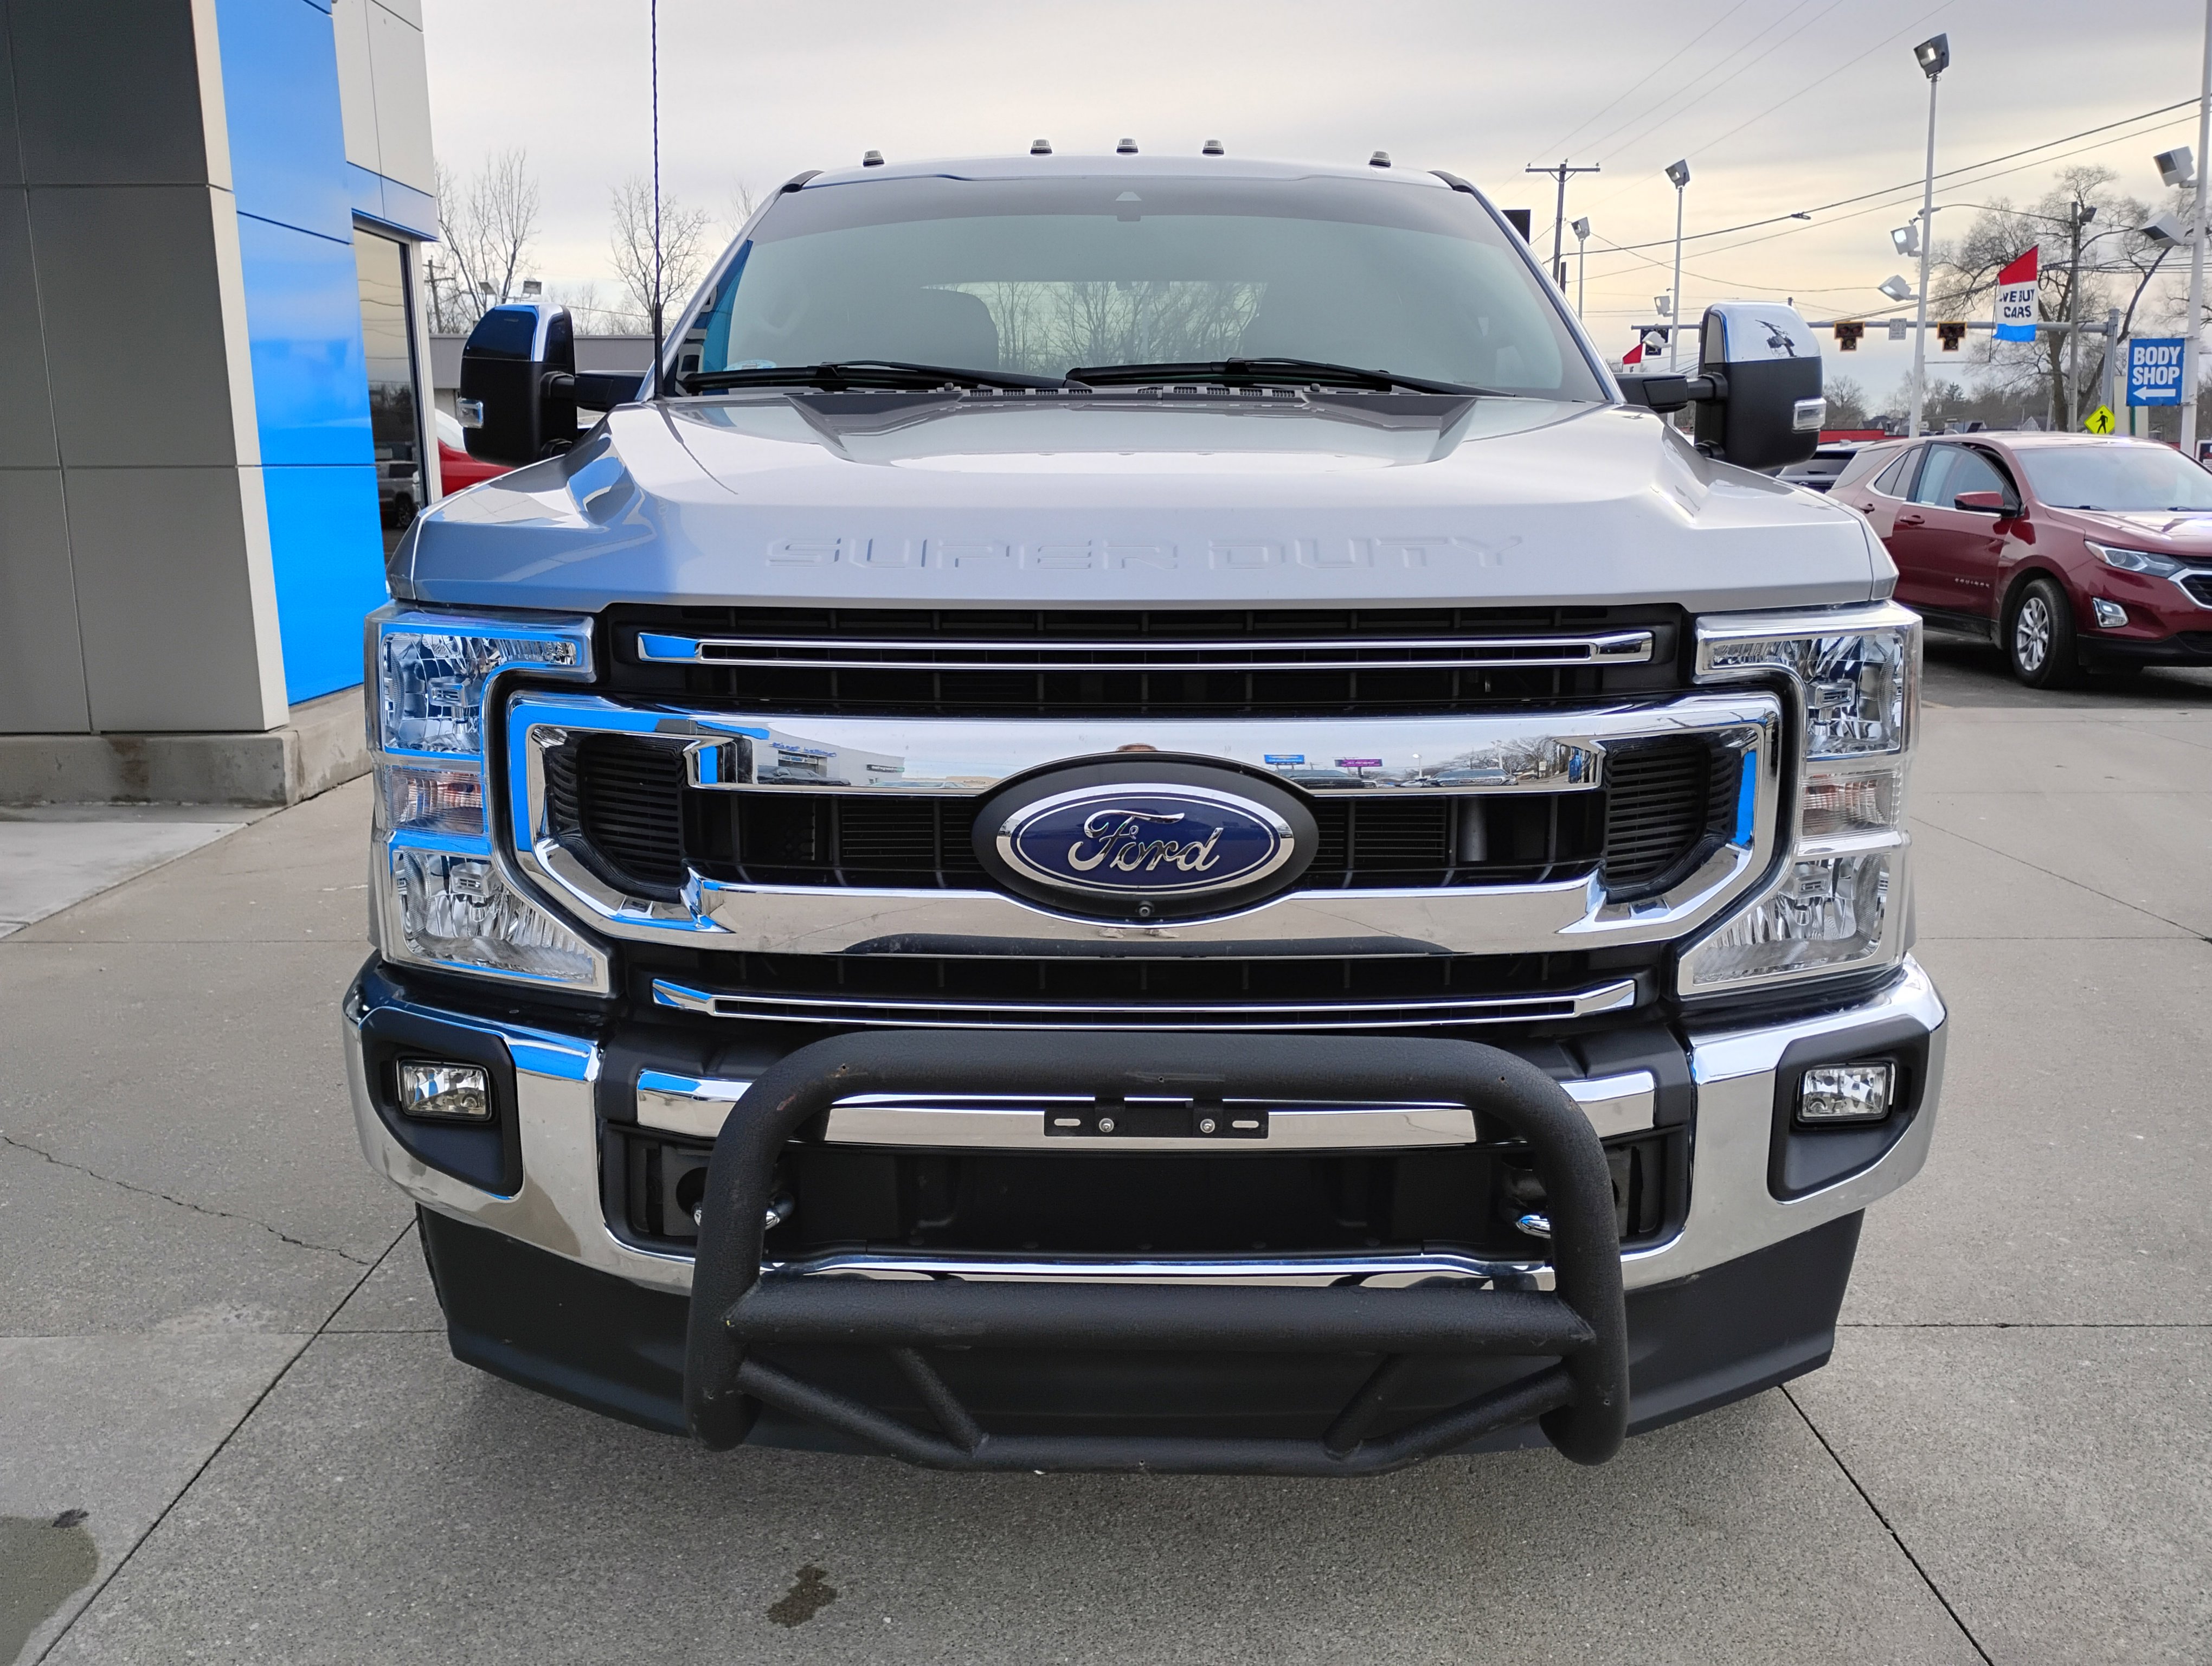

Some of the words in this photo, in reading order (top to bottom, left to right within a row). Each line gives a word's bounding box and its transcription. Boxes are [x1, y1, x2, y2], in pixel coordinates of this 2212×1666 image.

[2018, 289, 2035, 302] BUY
[2004, 305, 2031, 318] CARS
[2133, 346, 2181, 365] BODY
[2132, 366, 2180, 385] SHOP
[765, 537, 1178, 570] SUPER
[1208, 536, 1523, 570] DUTY
[1067, 809, 1224, 872] Ford
